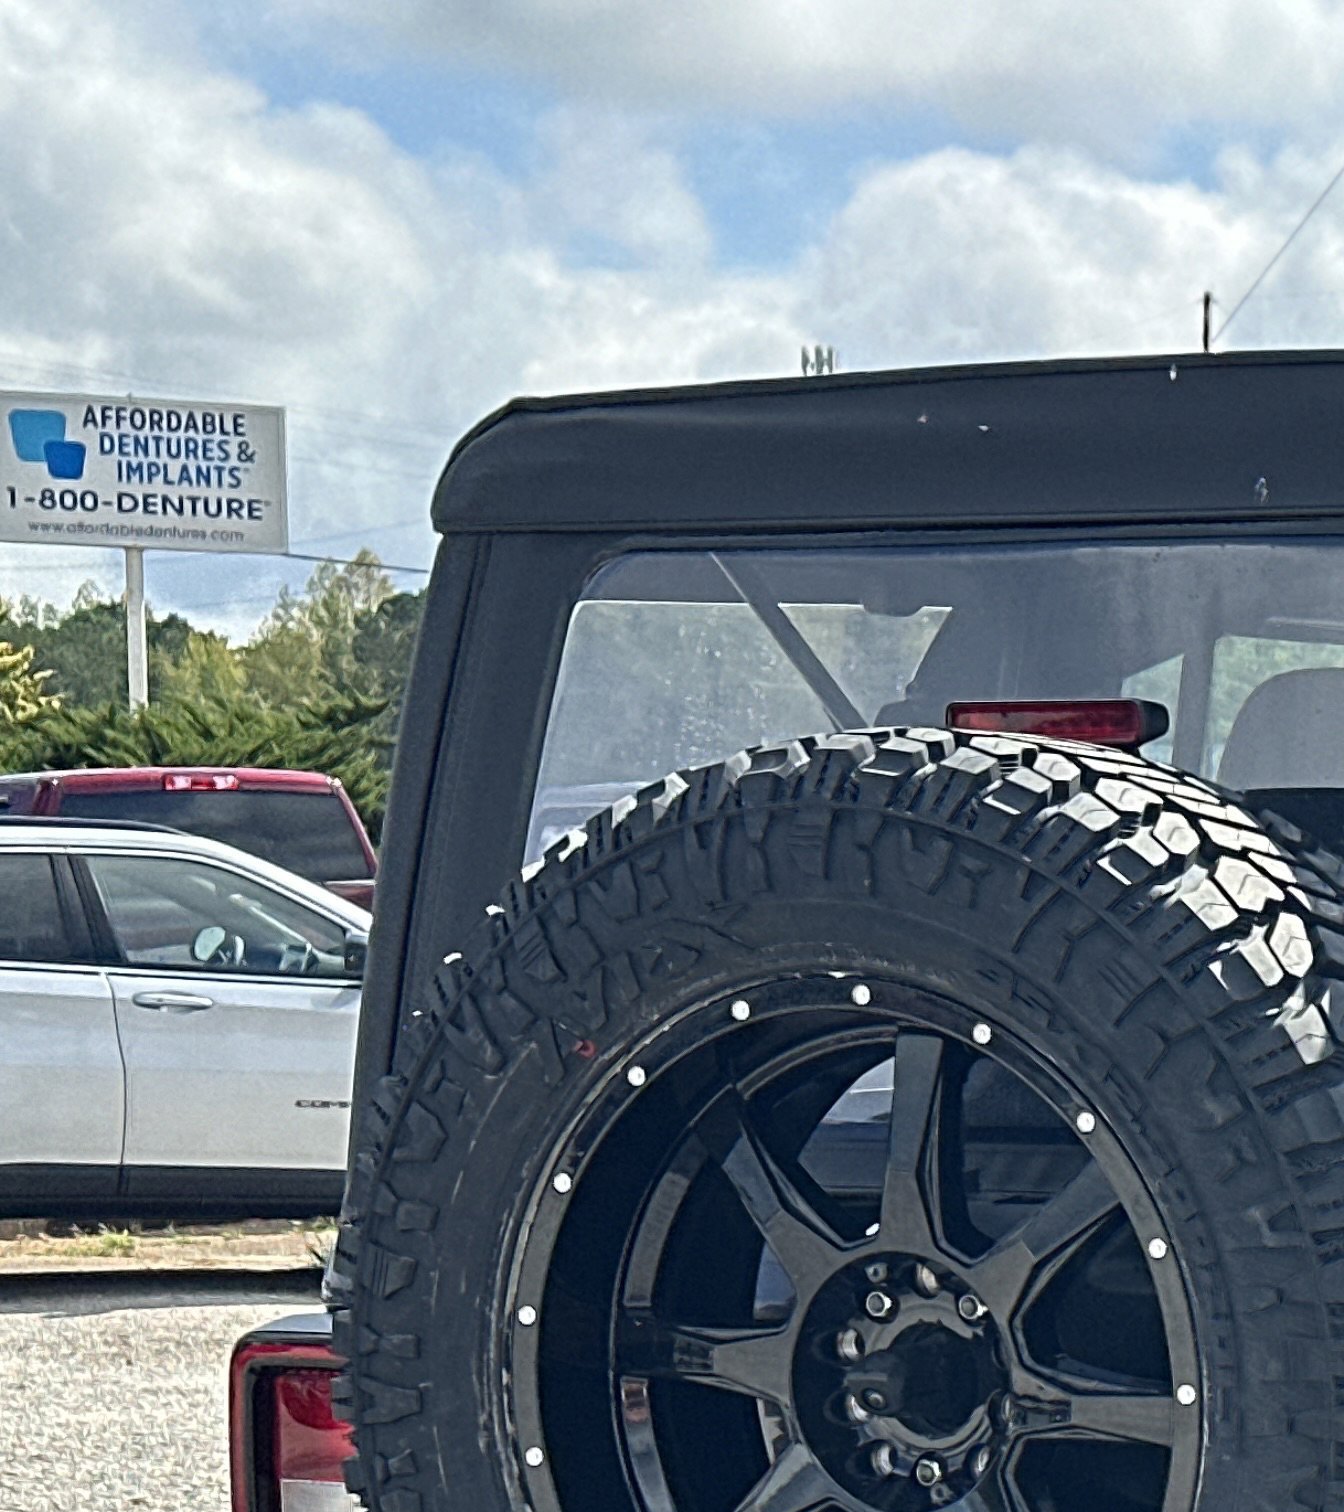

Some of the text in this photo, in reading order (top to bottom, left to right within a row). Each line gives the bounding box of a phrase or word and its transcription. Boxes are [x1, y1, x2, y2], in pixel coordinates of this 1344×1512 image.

[82, 404, 246, 437] AFFORDABLE
[99, 432, 256, 464] DENTURES &
[116, 460, 242, 489] IMPLANTS
[6, 486, 264, 521] 1-800-DENTURE
